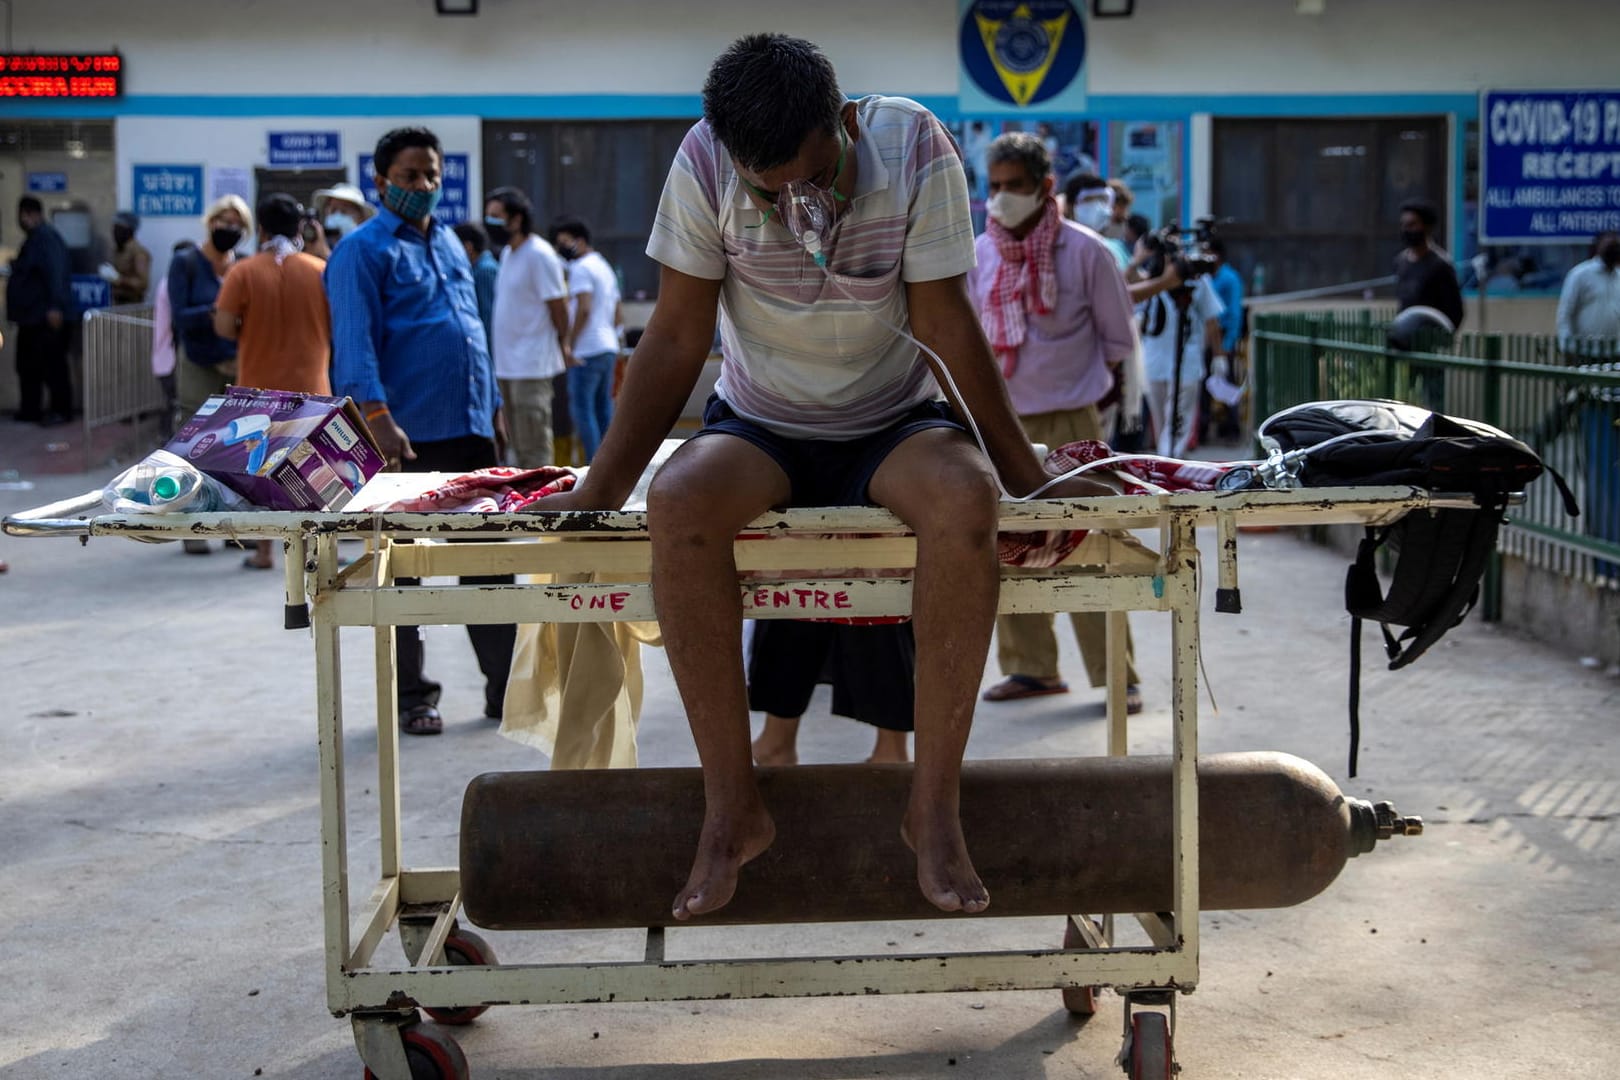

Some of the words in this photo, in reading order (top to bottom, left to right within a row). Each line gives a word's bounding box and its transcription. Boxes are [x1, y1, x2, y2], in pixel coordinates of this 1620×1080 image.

[1490, 100, 1600, 145] COVID-19
[138, 194, 197, 216] ENTRY
[1486, 187, 1512, 208] ALL
[1512, 187, 1605, 208] AMBULANCES
[1529, 212, 1556, 233] ALL
[331, 421, 352, 446] PHILIPS
